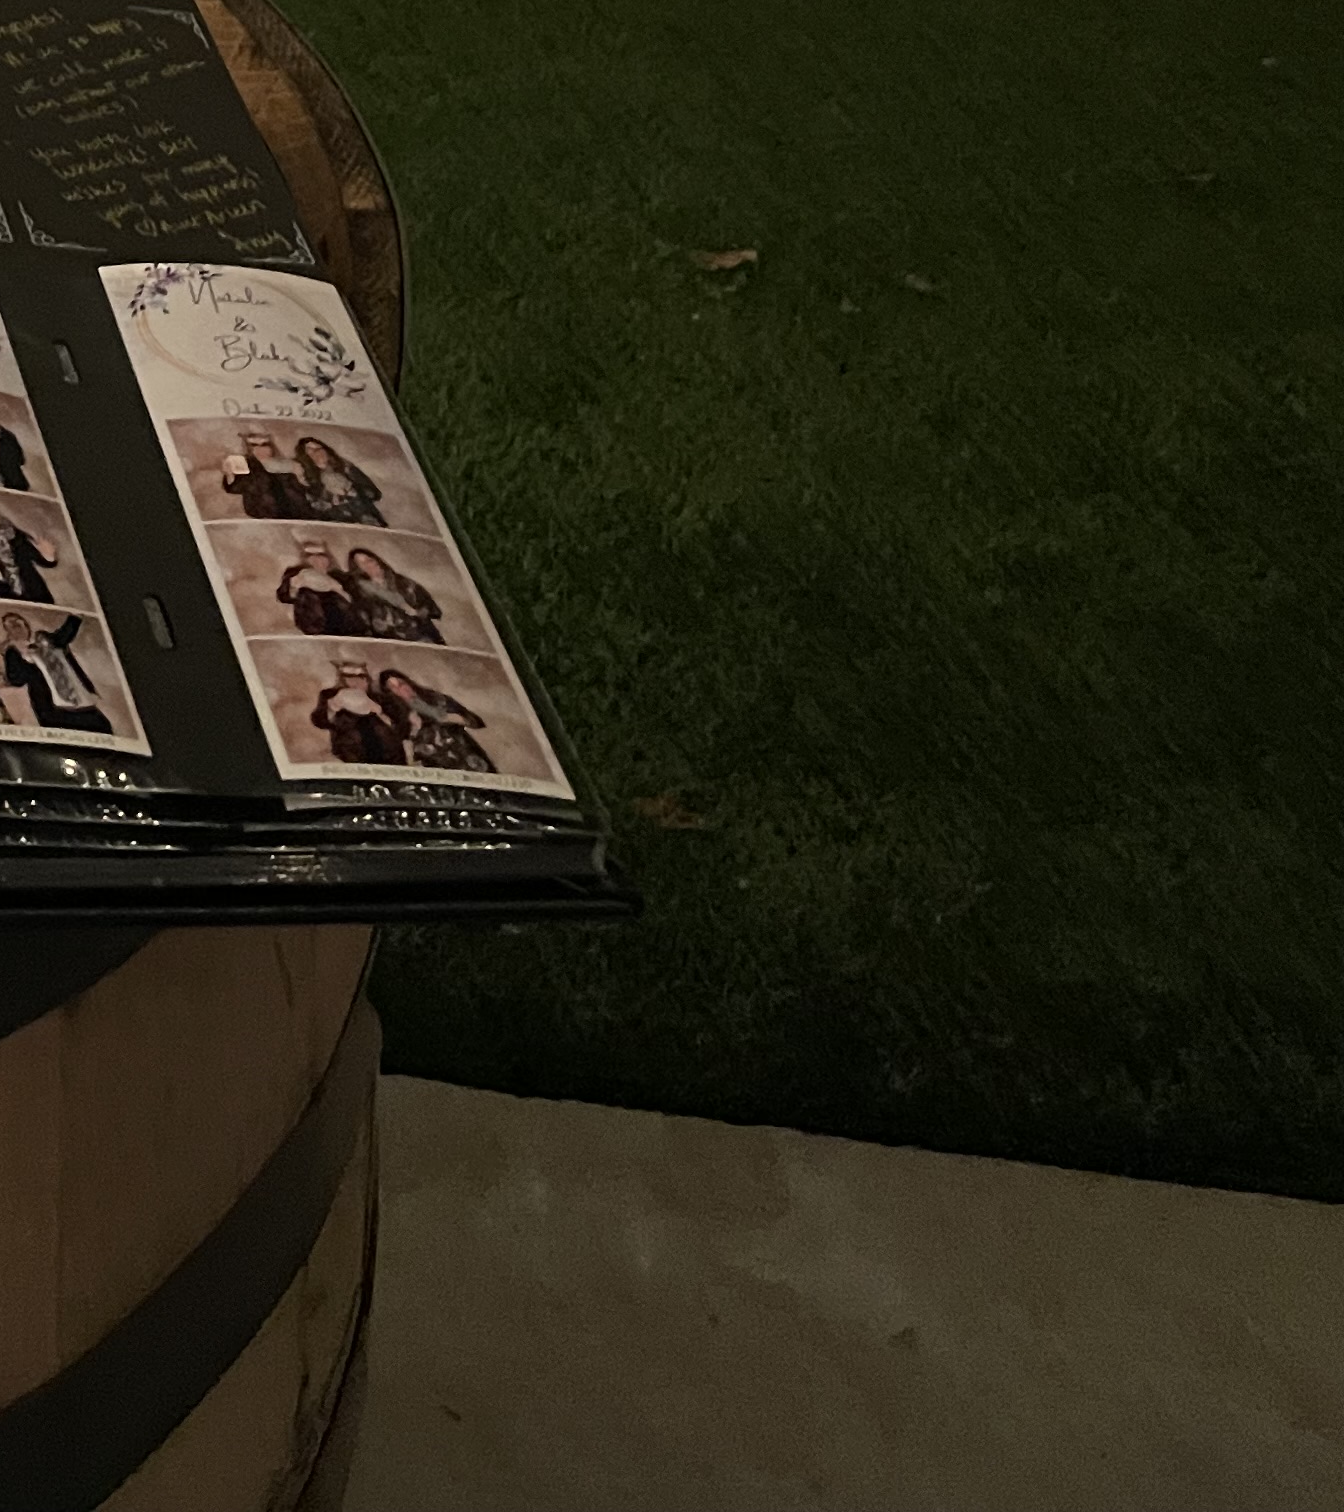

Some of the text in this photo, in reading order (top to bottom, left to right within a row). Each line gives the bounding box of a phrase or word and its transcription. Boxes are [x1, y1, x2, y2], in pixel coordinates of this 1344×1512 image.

[188, 277, 270, 314] Natalie
[233, 316, 256, 333] &
[214, 335, 291, 372] Blake
